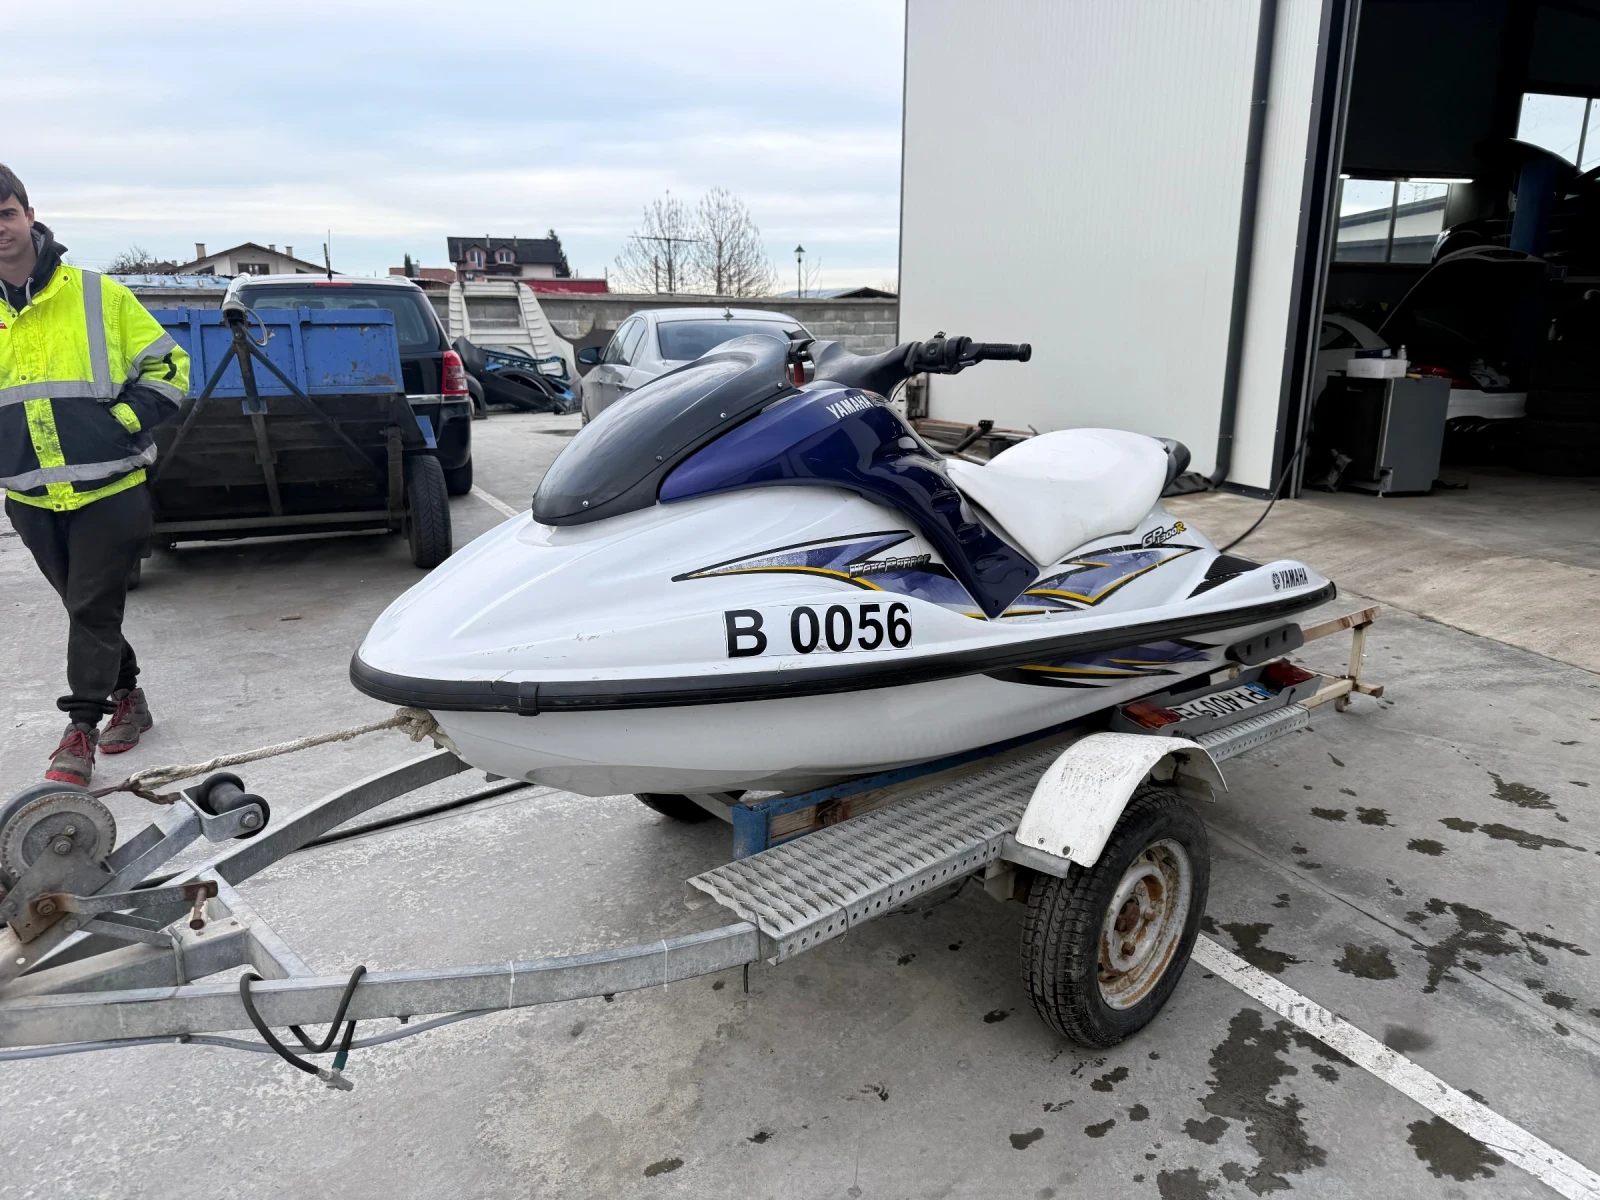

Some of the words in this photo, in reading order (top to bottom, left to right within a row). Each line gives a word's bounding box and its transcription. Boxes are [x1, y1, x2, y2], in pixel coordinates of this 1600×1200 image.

[825, 394, 874, 419] YAMAHA
[1279, 567, 1308, 589] YAMAHA
[724, 609, 767, 658] B
[790, 602, 912, 654] 0056
